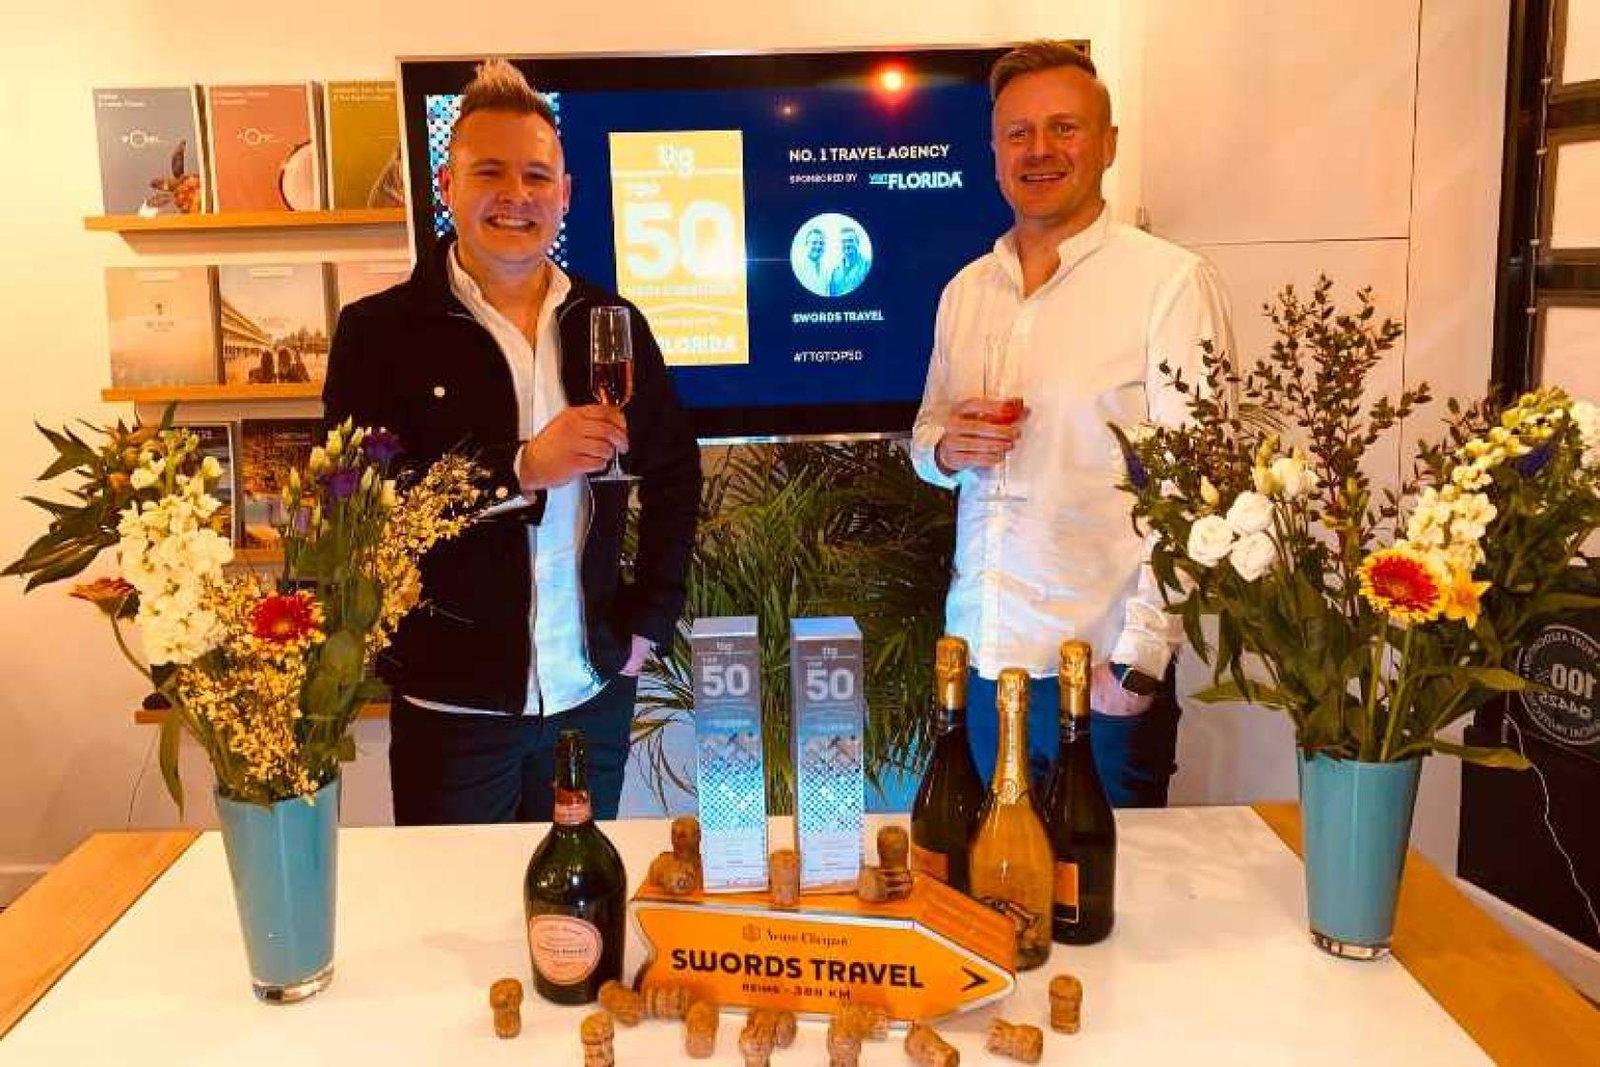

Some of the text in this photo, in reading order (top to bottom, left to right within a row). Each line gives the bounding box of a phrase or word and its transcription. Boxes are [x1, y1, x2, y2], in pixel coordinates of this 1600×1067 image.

[789, 145, 950, 163] NO. 1 TRAVEL AGENCY
[888, 171, 963, 189] FLORIDA
[626, 200, 735, 277] 50
[792, 309, 884, 323] SWORDS TRAVEL
[702, 663, 750, 696] 50
[806, 667, 854, 700] 50
[671, 948, 924, 989] SWORDS TRAVEL
[829, 988, 851, 1000] KM
